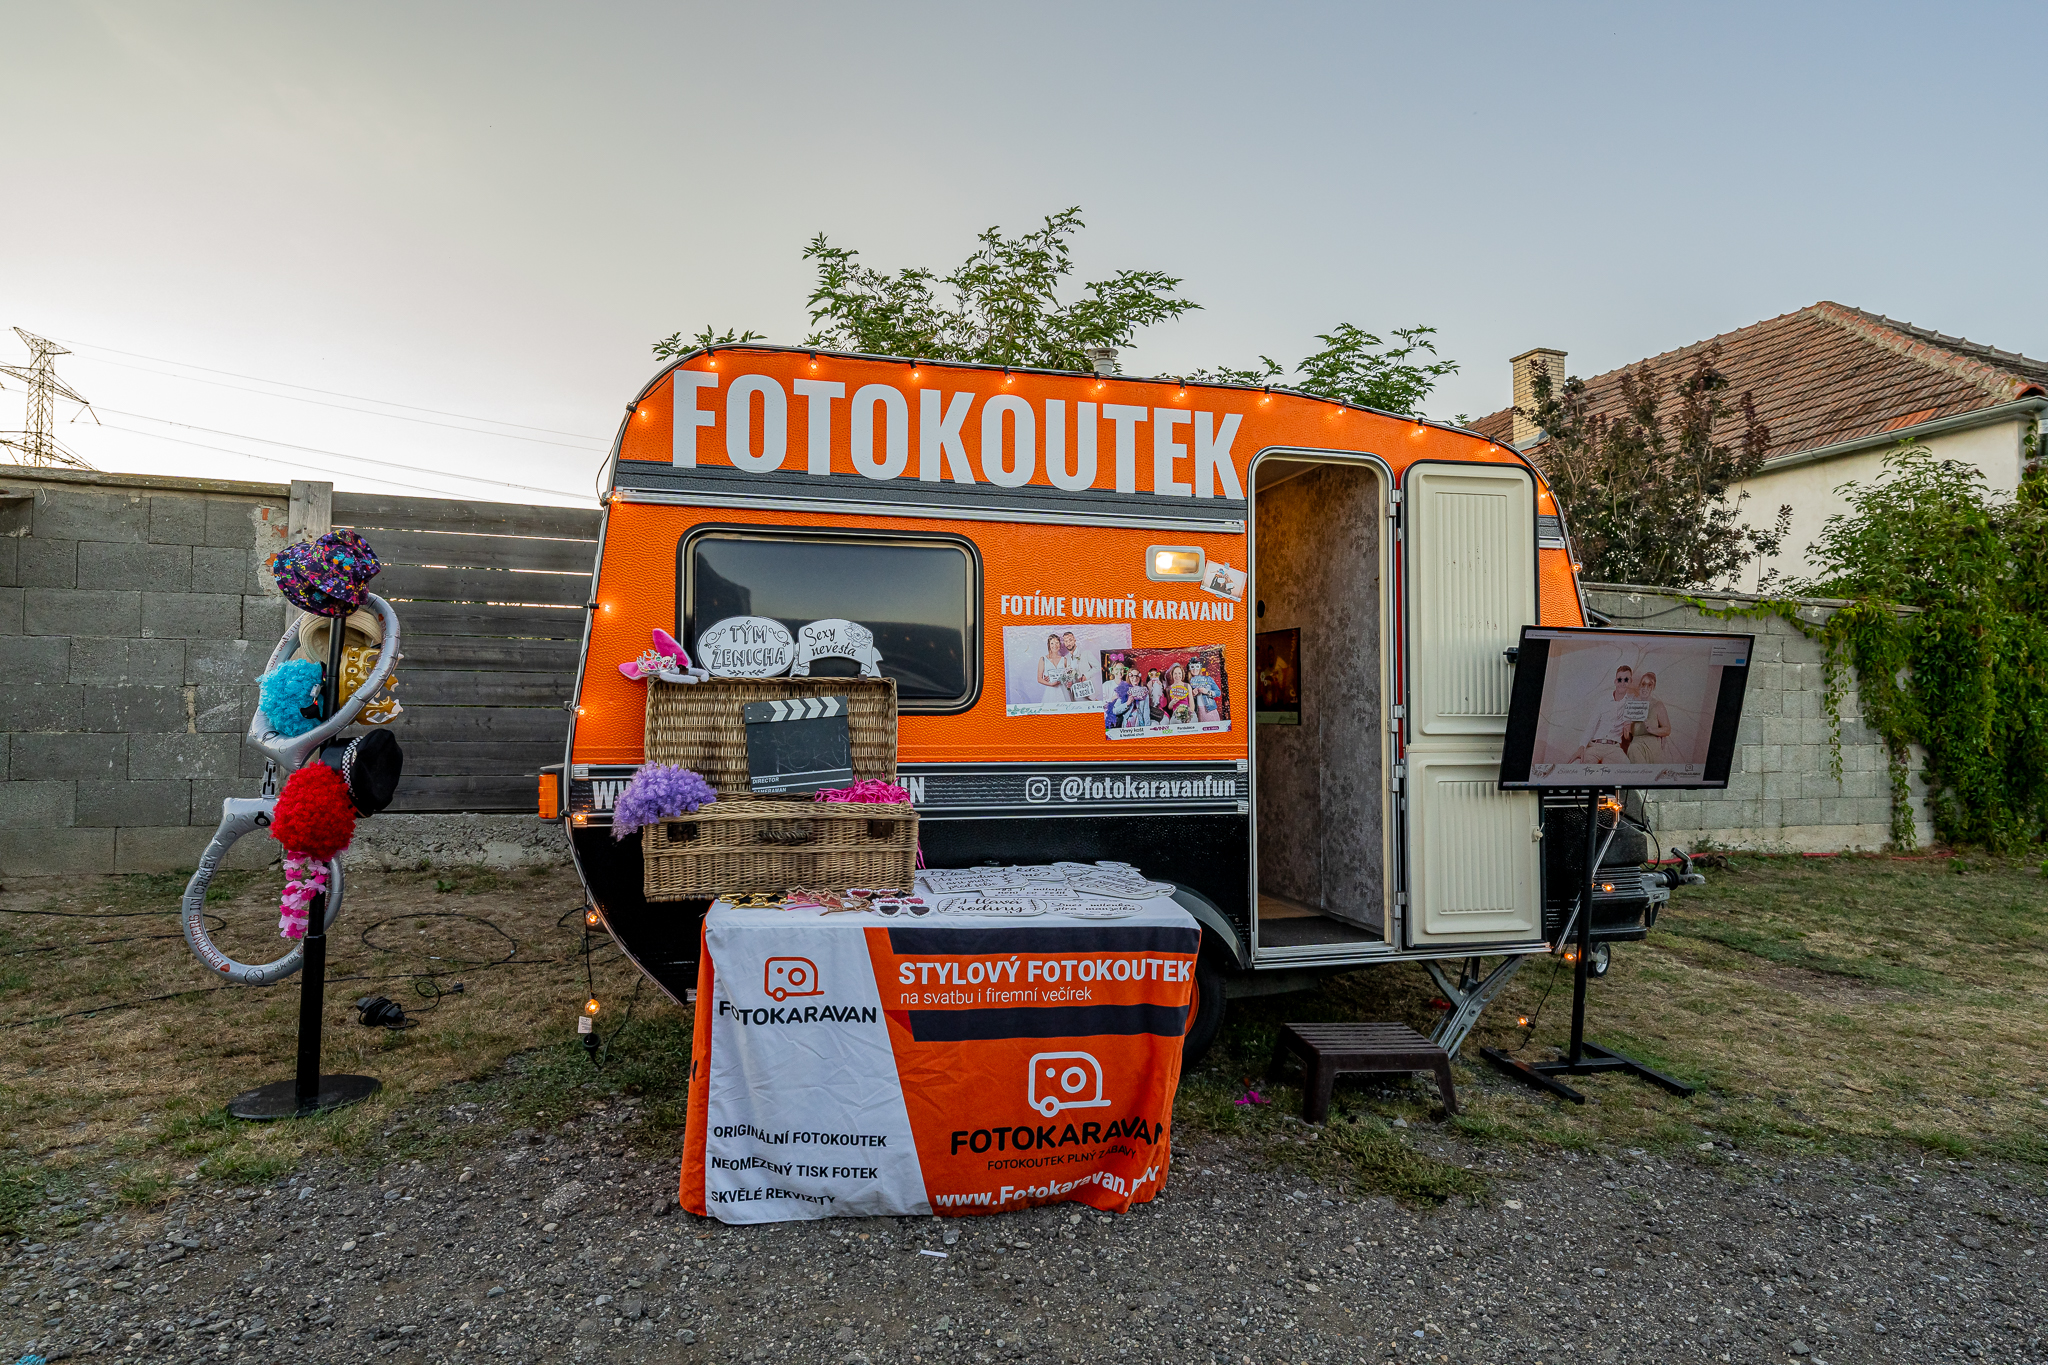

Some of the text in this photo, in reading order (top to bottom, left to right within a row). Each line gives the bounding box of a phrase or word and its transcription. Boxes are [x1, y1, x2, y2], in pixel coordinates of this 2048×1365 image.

[672, 369, 1245, 500] FOTOKOUTEK
[1001, 590, 1234, 622] FOTÍME UVNITŘ KARAVANU
[730, 619, 768, 644] TÝM
[804, 627, 836, 647] Sexy
[711, 644, 786, 670] ŽENICHA
[811, 640, 857, 657] nevěsta
[752, 776, 780, 785] DIRECTOR
[1060, 775, 1236, 802] @fotokaravanfun
[189, 898, 202, 911] IN
[188, 914, 224, 969] PARTNERS
[898, 956, 1194, 985] STYLOVÝ FOTOKOUTEK
[900, 986, 1092, 1004] na svatbu i firemní večírek
[719, 1000, 877, 1026] FOTOKARAVAN
[713, 1124, 887, 1147] ORIGINÁLNÍ FOTOKOUTEK
[711, 1156, 878, 1179] NEOMEZENÝ TISK FOTEK
[987, 1155, 1065, 1171] FOTOKOUTEK
[1067, 1150, 1097, 1164] PLNÝ
[711, 1187, 836, 1206] SKVĚLÉ REKVIZITY
